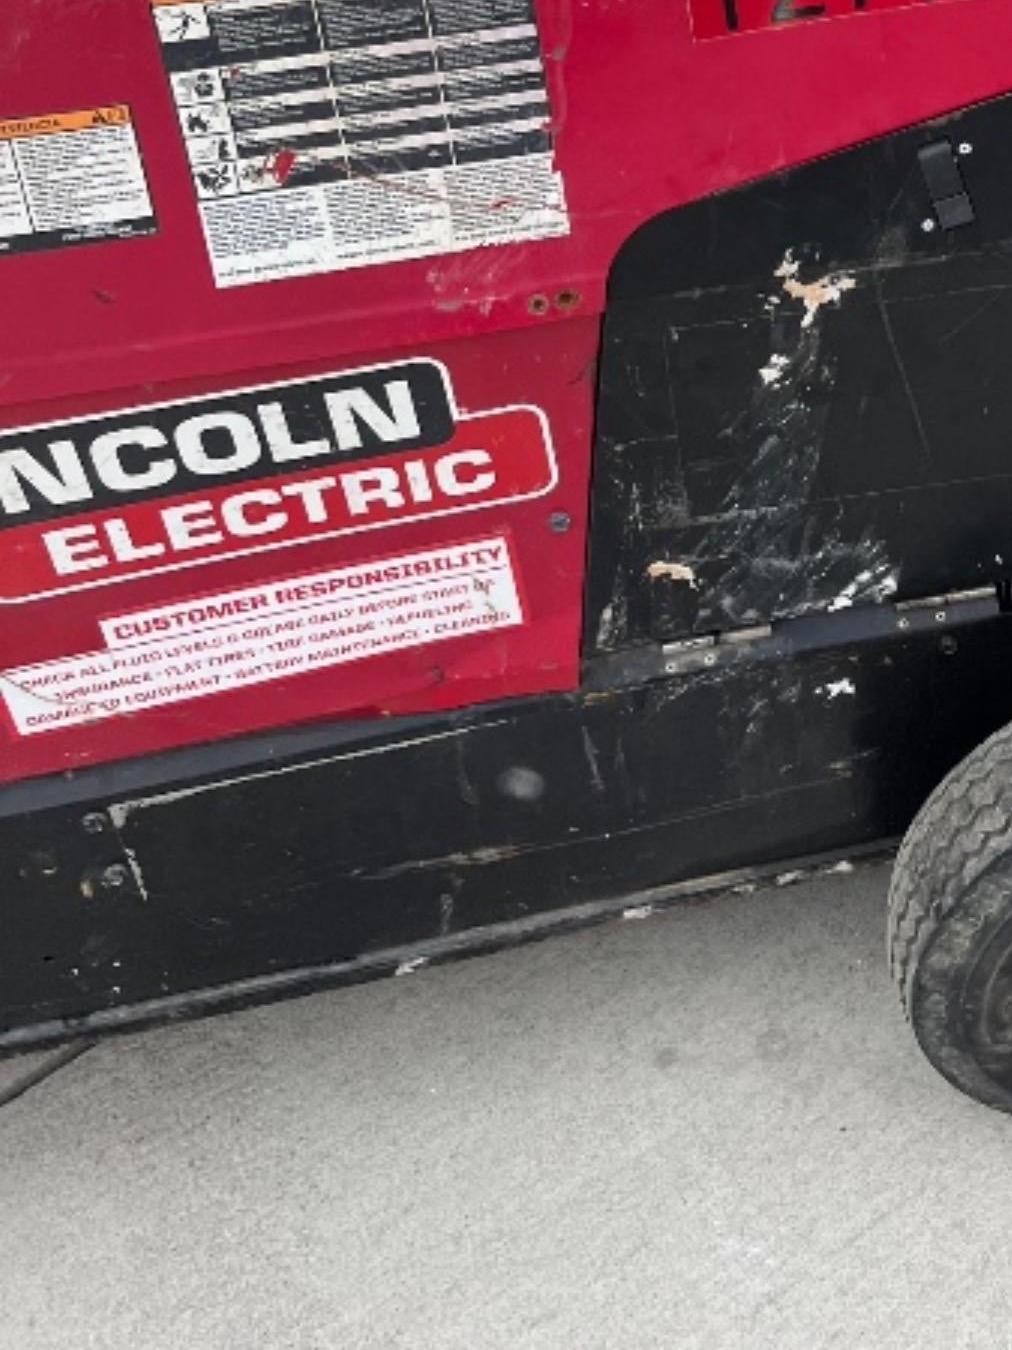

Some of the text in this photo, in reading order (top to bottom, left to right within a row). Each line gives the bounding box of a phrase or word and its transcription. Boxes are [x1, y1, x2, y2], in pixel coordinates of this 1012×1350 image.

[0, 380, 422, 514] NCOLN
[41, 449, 497, 577] ELECTRIC
[112, 652, 162, 670] FLUID
[165, 636, 222, 658] LEVELS
[242, 614, 305, 639] GREASE
[308, 607, 354, 625] DAILY
[359, 594, 417, 616] BEFORE
[113, 546, 502, 640] CUSTOMER RESPONSIBILITY
[165, 661, 201, 677] FLAT
[207, 649, 256, 667] TIRES
[308, 621, 376, 642] DAMAGE
